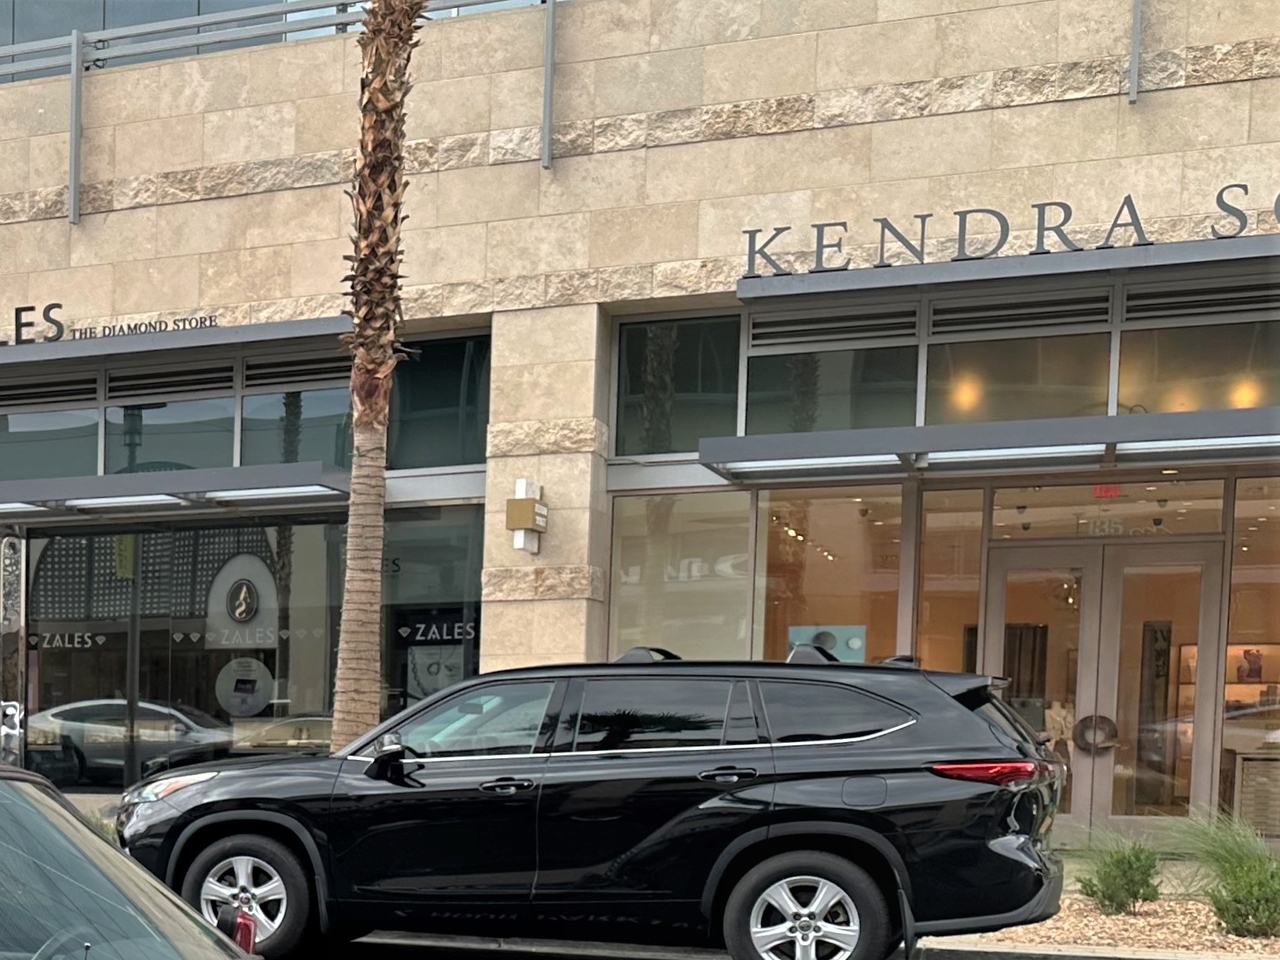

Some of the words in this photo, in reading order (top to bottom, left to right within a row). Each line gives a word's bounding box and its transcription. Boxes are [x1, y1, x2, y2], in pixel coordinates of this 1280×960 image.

[742, 194, 1154, 278] KENDRA
[1210, 183, 1280, 240] S
[70, 327, 97, 340] THE
[102, 320, 168, 338] DIAMOND
[172, 315, 218, 331] STORE
[42, 633, 92, 648] ZALES
[221, 628, 274, 645] ZALES
[415, 622, 475, 641] ZALES
